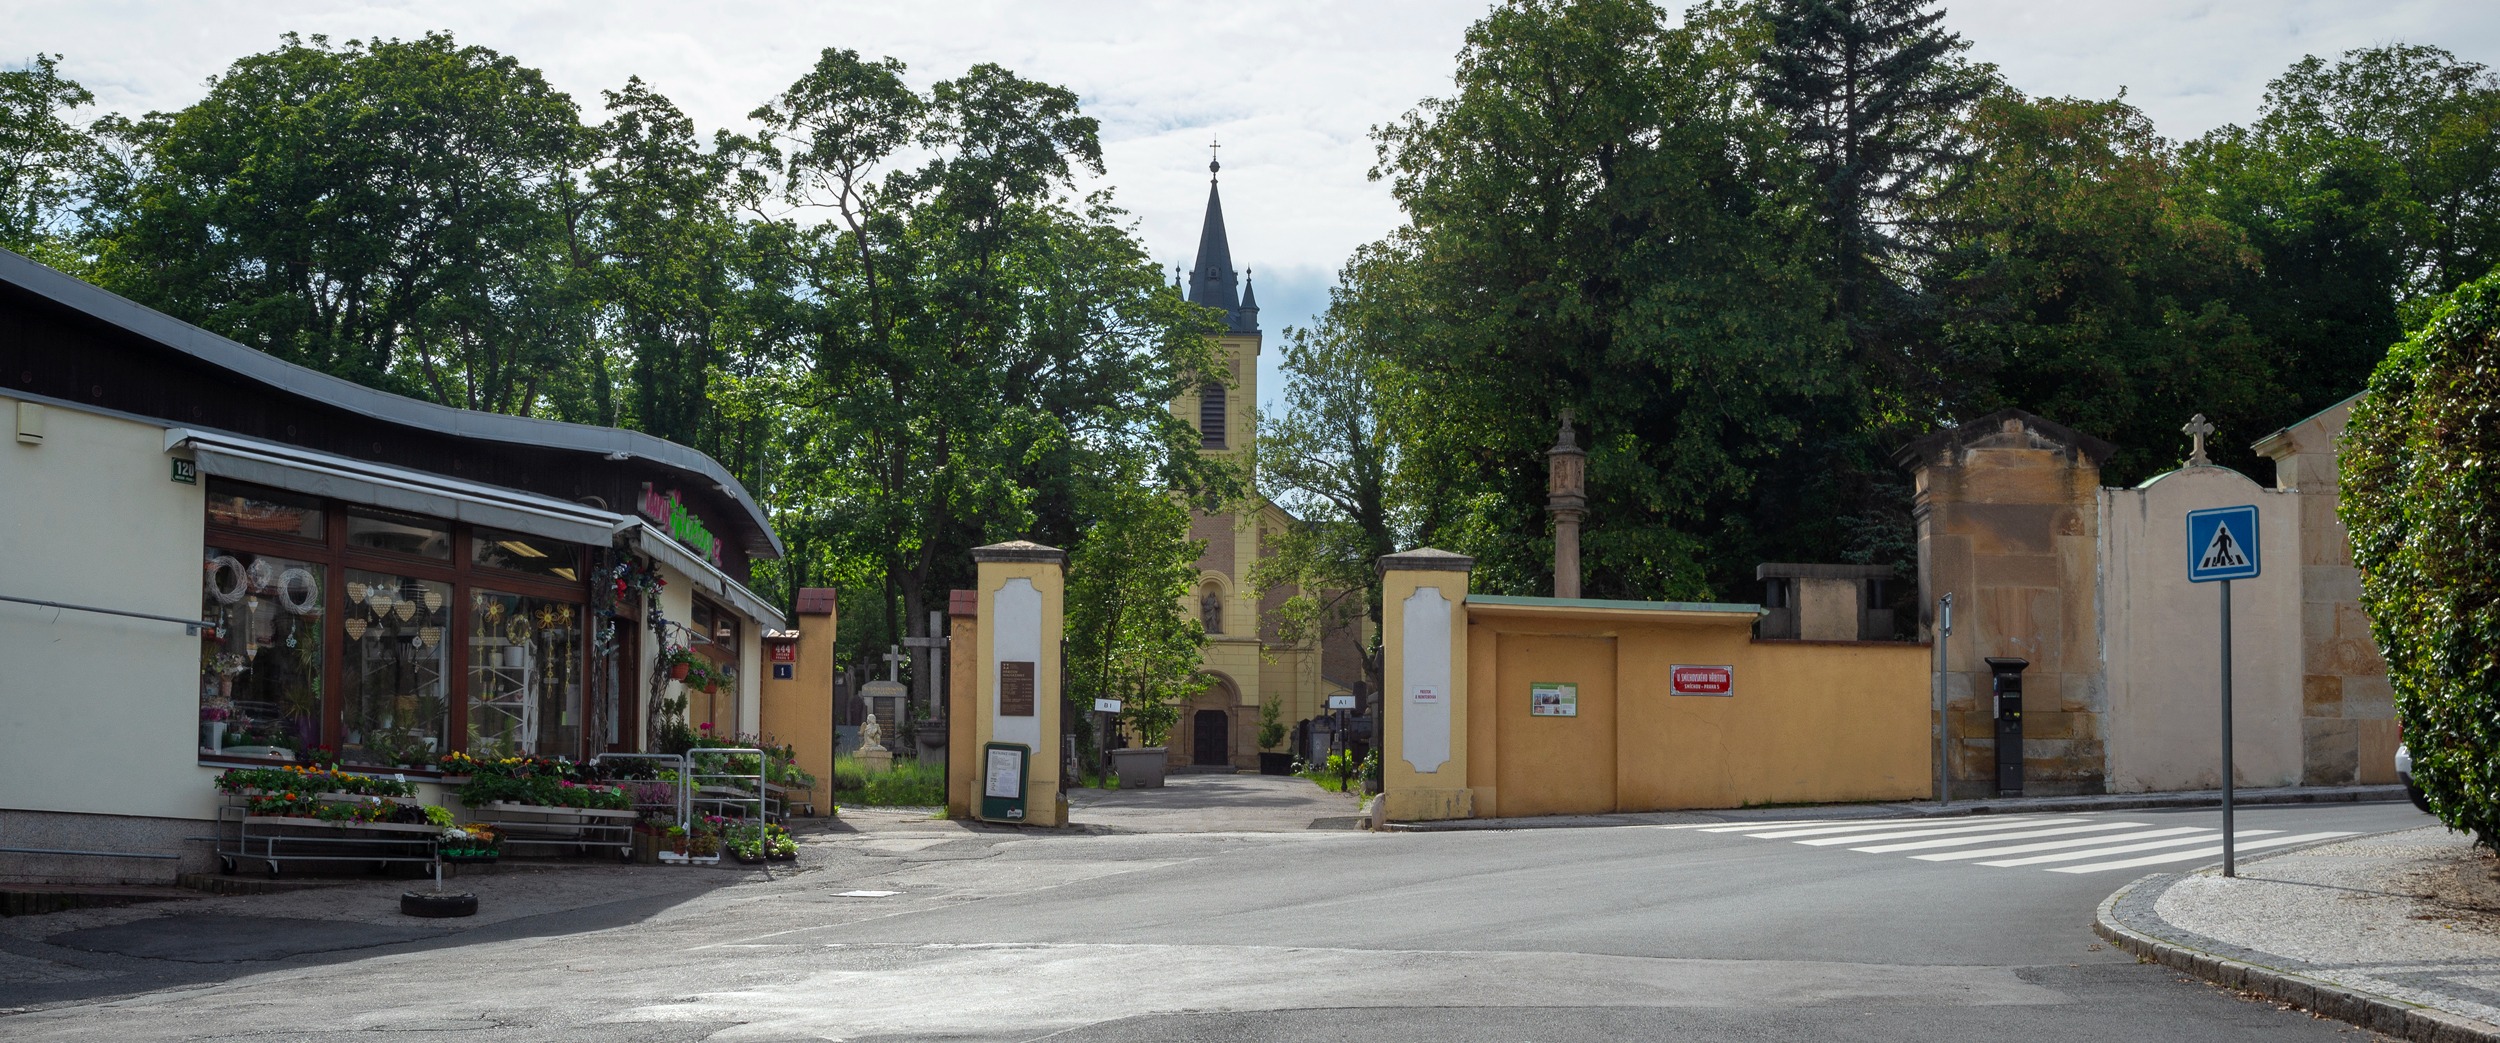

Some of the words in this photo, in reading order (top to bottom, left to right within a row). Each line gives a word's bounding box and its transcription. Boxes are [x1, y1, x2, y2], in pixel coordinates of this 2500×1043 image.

[176, 461, 194, 477] 120
[775, 644, 790, 653] 444
[1677, 673, 1680, 681] U
